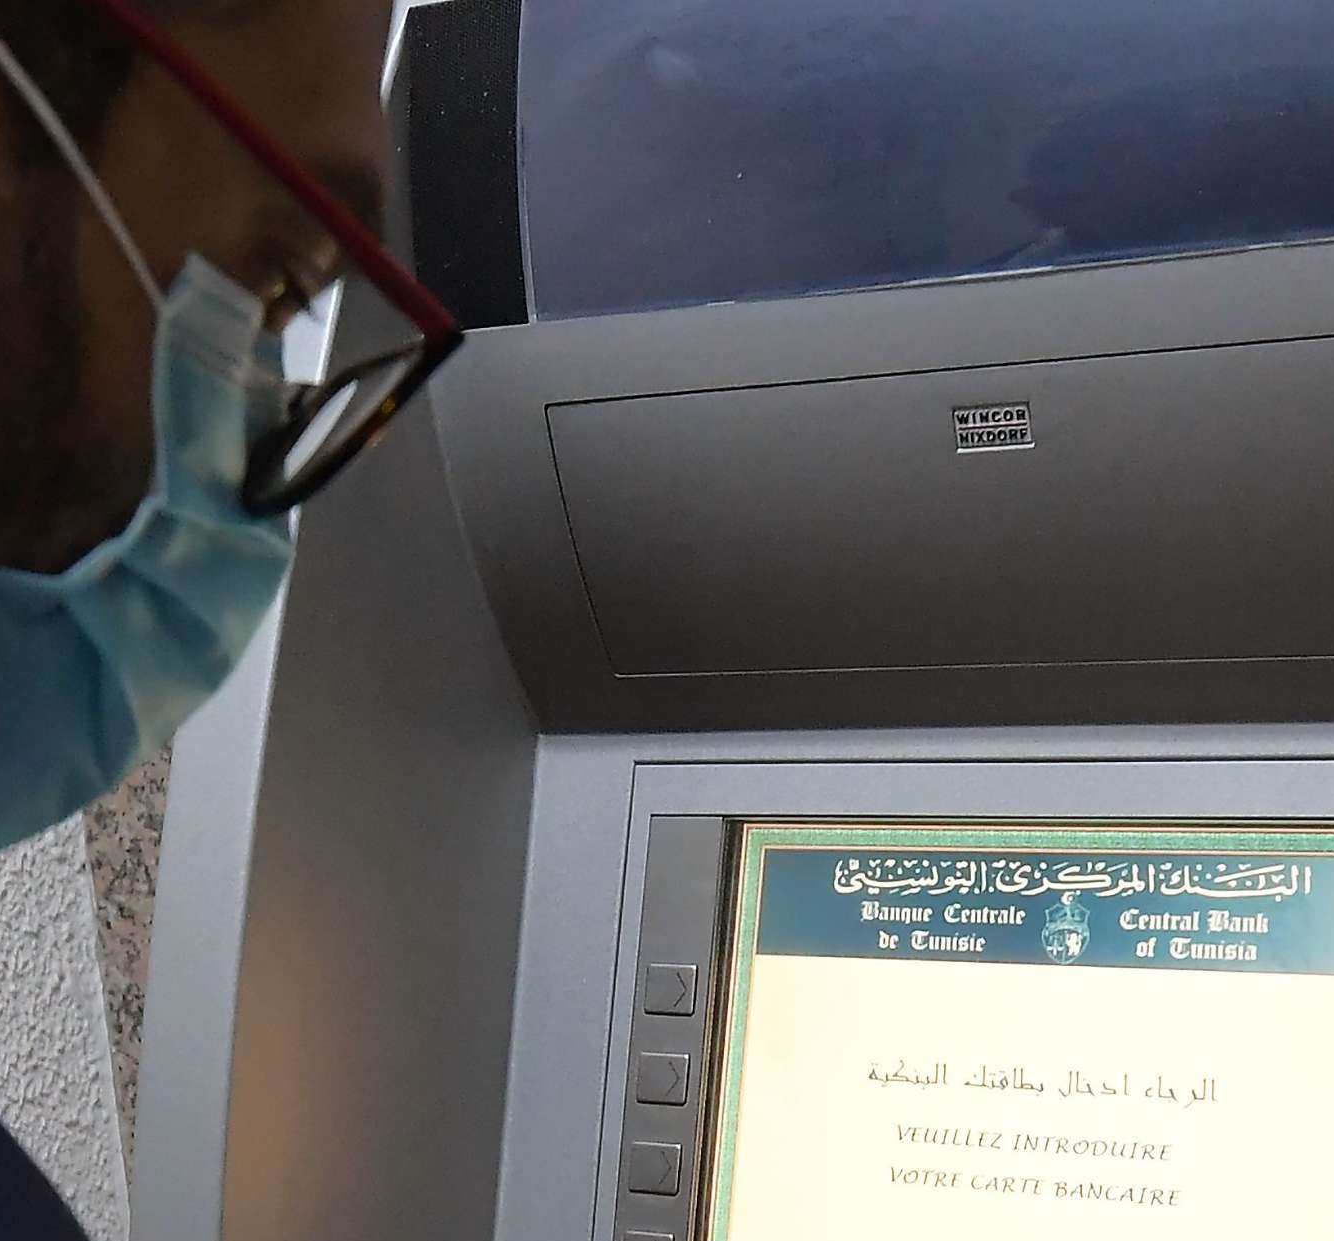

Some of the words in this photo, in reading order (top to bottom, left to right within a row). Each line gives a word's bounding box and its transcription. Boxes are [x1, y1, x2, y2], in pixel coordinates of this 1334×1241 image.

[955, 408, 1027, 425] WINCOR
[958, 428, 1028, 444] NIXDORF
[860, 900, 934, 925] Banque
[942, 903, 1027, 926] Centrale
[1119, 908, 1201, 932] Central
[1206, 909, 1270, 934] Bank
[877, 929, 900, 950] de
[910, 930, 987, 953] Tunisie
[1135, 936, 1157, 959] of
[1169, 936, 1258, 961] Tunisia
[1144, 1076, 1218, 1110] الرجاء
[897, 1124, 1002, 1150] VEUILLEZ
[1013, 1133, 1173, 1161] INTRODUIRE
[890, 1166, 964, 1188] VOTRE
[970, 1174, 1046, 1196] CARTE
[1054, 1180, 1182, 1206] BANCAIRE
